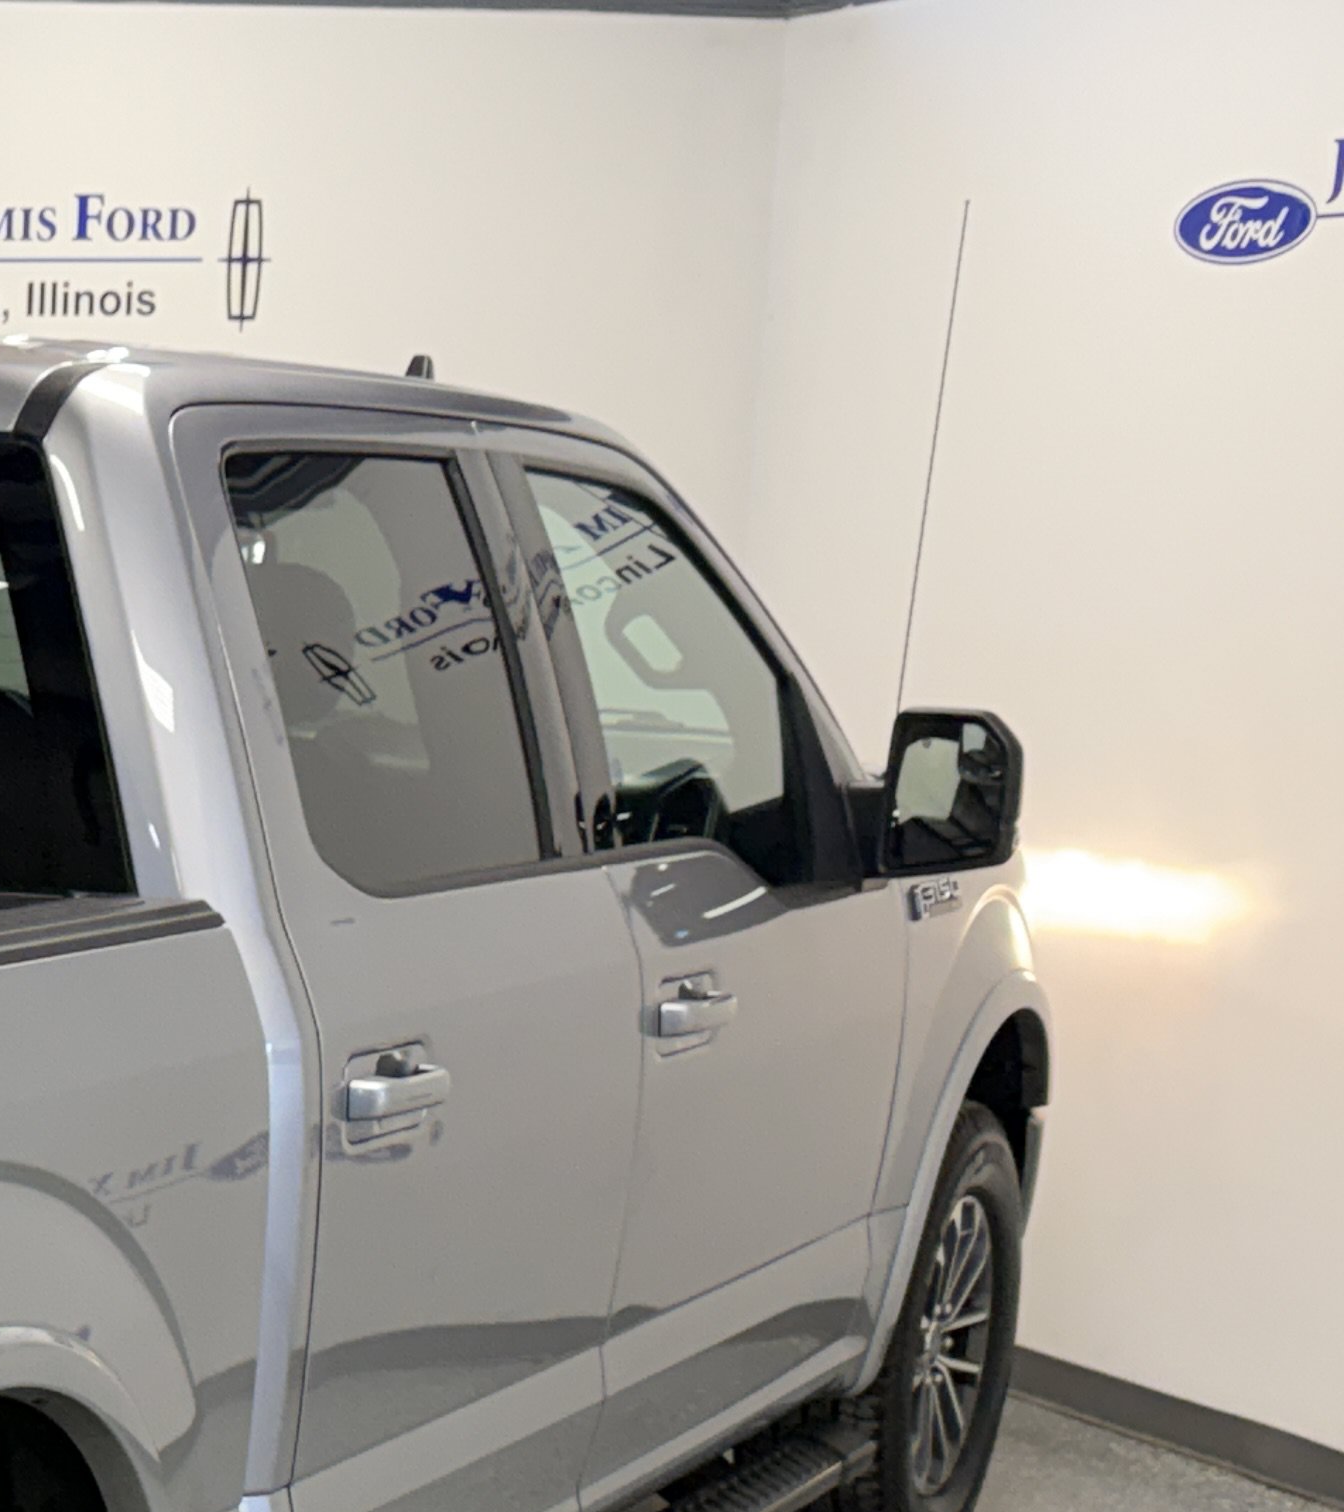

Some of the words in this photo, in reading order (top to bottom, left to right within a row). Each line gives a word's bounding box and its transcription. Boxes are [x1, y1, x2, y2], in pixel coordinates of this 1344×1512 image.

[71, 193, 196, 242] FORD
[1199, 195, 1289, 250] Ford
[25, 281, 156, 317] Illinois
